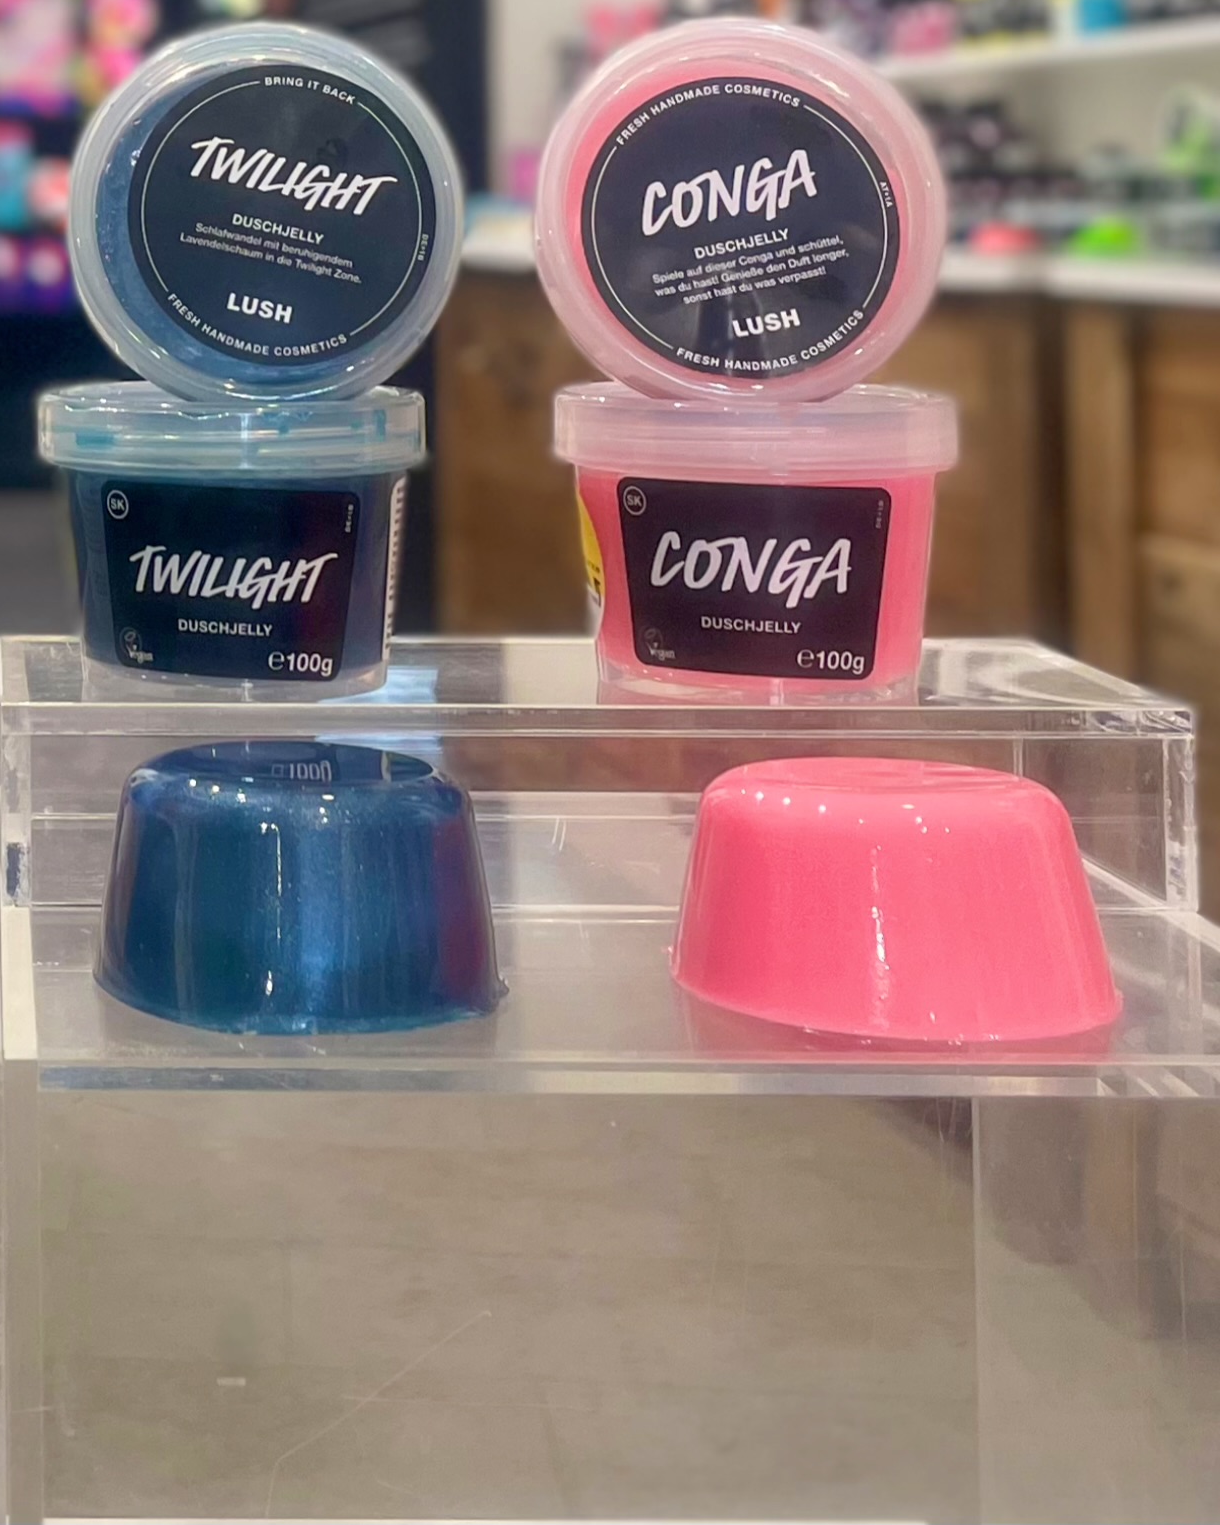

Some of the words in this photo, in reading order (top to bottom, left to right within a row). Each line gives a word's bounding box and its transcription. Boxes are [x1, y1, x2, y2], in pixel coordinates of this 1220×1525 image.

[265, 75, 304, 89] BRING
[308, 78, 320, 91] IT
[323, 83, 356, 105] BACK
[615, 111, 651, 146] FRESH
[650, 84, 721, 117] HANDMADE
[724, 84, 802, 108] COSMETICS
[190, 136, 398, 216] TWILIGHT
[641, 149, 818, 237] CONGA
[195, 222, 262, 246] Schlafwandel
[264, 239, 280, 251] mit
[282, 243, 353, 268] beruhigendem
[232, 213, 324, 245] DUSCHJELLY
[694, 228, 789, 259] DUSCHJELLY
[180, 232, 263, 259] Lavendelschaum
[265, 252, 275, 261] in
[277, 255, 292, 267] die
[295, 258, 332, 276] Twilight
[333, 269, 361, 284] Zone.
[652, 270, 685, 285] Spiele
[686, 265, 704, 278] auf
[704, 260, 737, 274] dieser
[738, 253, 774, 267] Conga
[775, 245, 796, 258] und
[655, 286, 676, 297] was
[677, 280, 693, 293] du
[693, 274, 720, 290] hast!
[721, 266, 764, 283] Genieße
[765, 260, 786, 274] den
[787, 255, 811, 269] Duft
[683, 292, 713, 305] sonst
[714, 286, 737, 299] hast
[738, 281, 753, 293] du
[754, 278, 777, 289] was
[778, 266, 826, 285] verpasst!
[167, 293, 201, 327] FRESH
[201, 323, 269, 356] HANDMADE
[273, 333, 348, 357] COSMETICS
[226, 292, 293, 324] LUSH
[732, 308, 800, 338] LUSH
[676, 347, 719, 368] FRESH
[724, 355, 798, 371] HANDMADE
[800, 309, 864, 360] COSMETICS
[111, 498, 125, 510] SK
[626, 495, 642, 506] SK
[129, 545, 338, 610] TWILIGHT
[650, 531, 853, 609] CONGA
[178, 618, 272, 637] DUSCHJELLY
[701, 616, 802, 634] DUSCHJELLY
